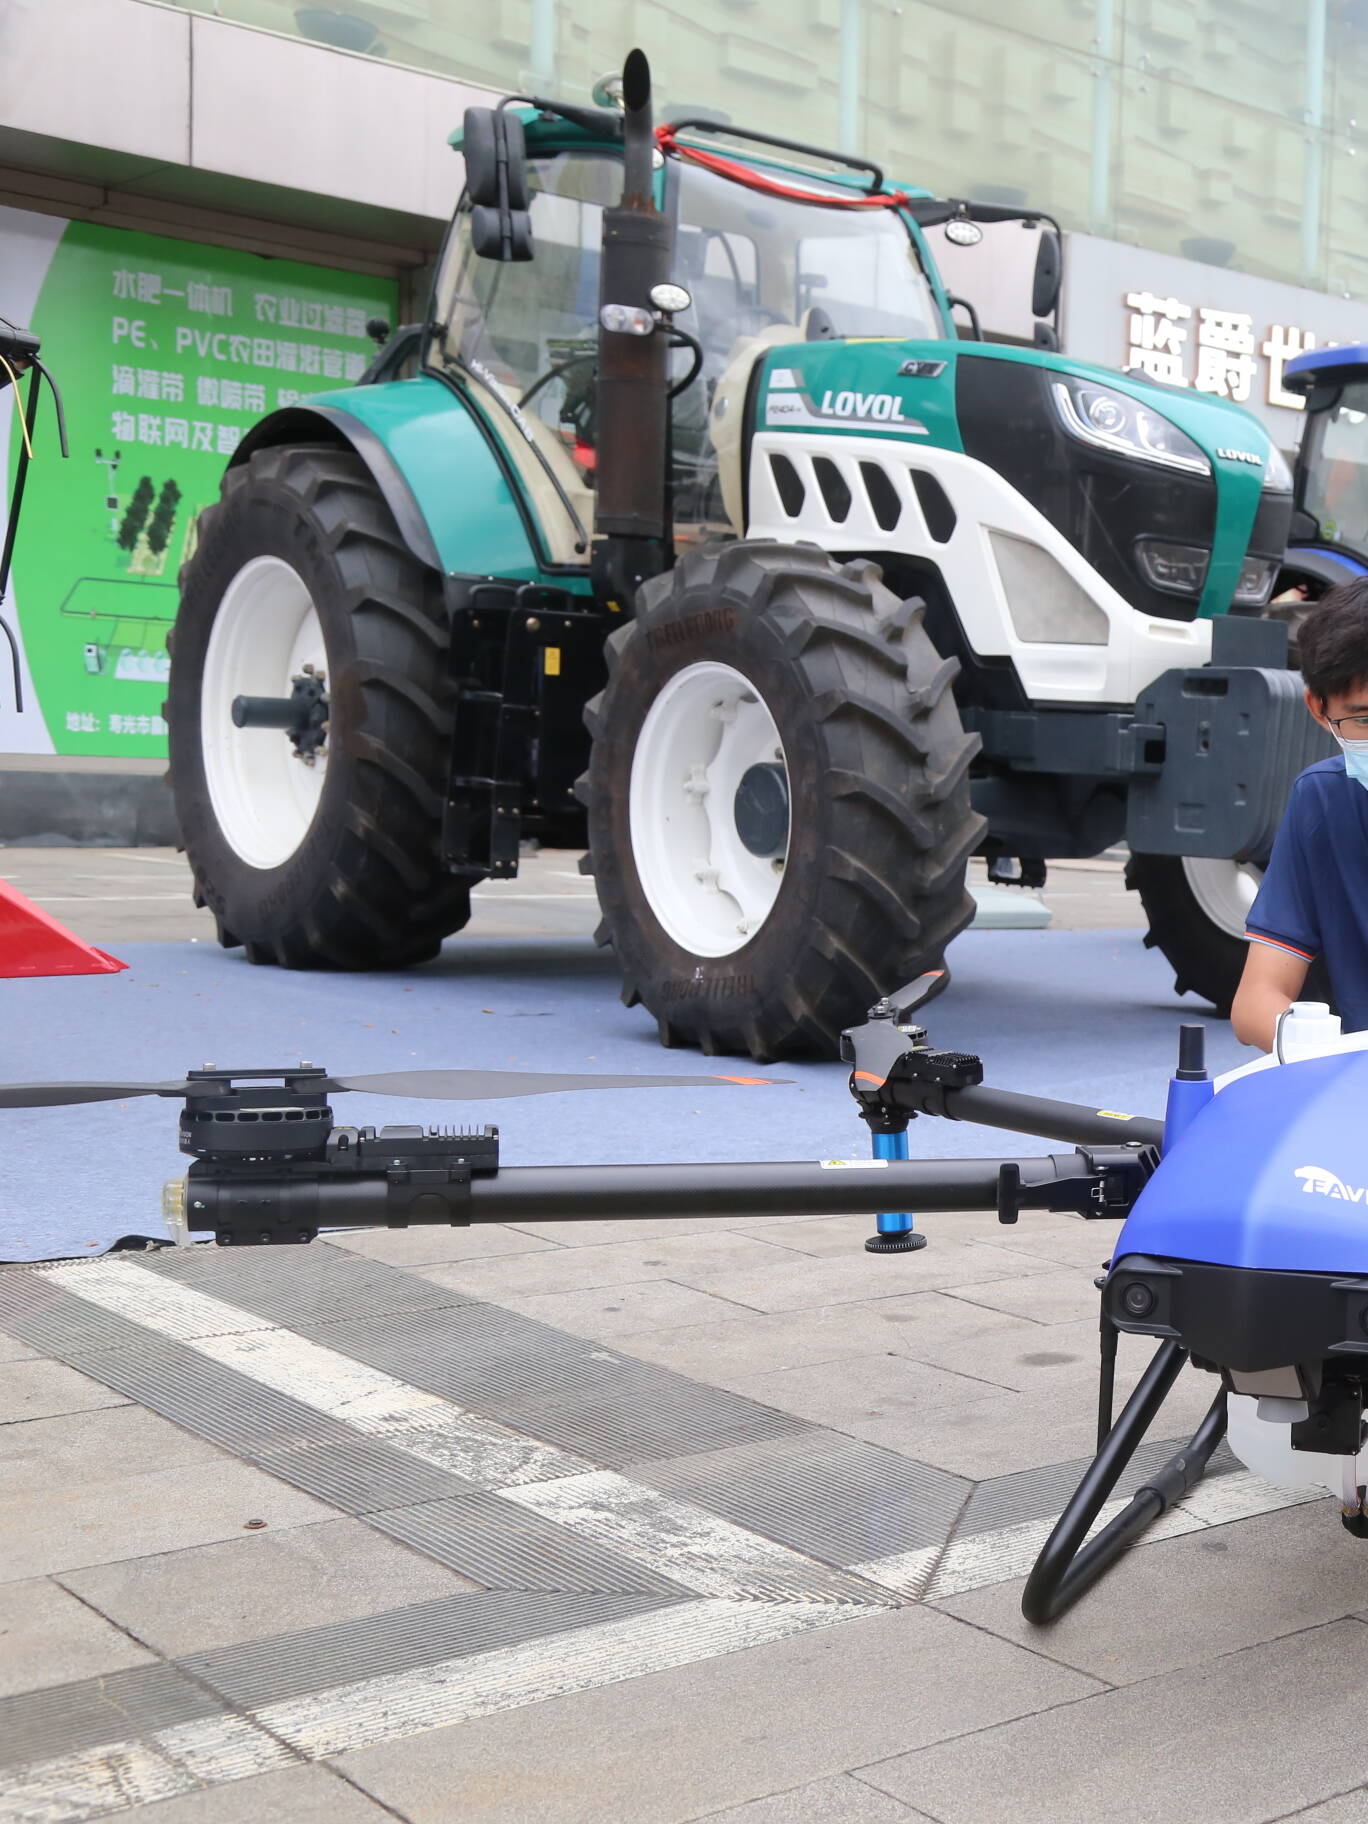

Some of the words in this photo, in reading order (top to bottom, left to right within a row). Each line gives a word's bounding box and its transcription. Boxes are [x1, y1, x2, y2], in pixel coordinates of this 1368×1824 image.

[113, 269, 233, 317] 水肥一体机
[821, 390, 905, 421] LOVOL
[111, 410, 251, 455] 物联网及智
[1216, 447, 1264, 466] LOVOL
